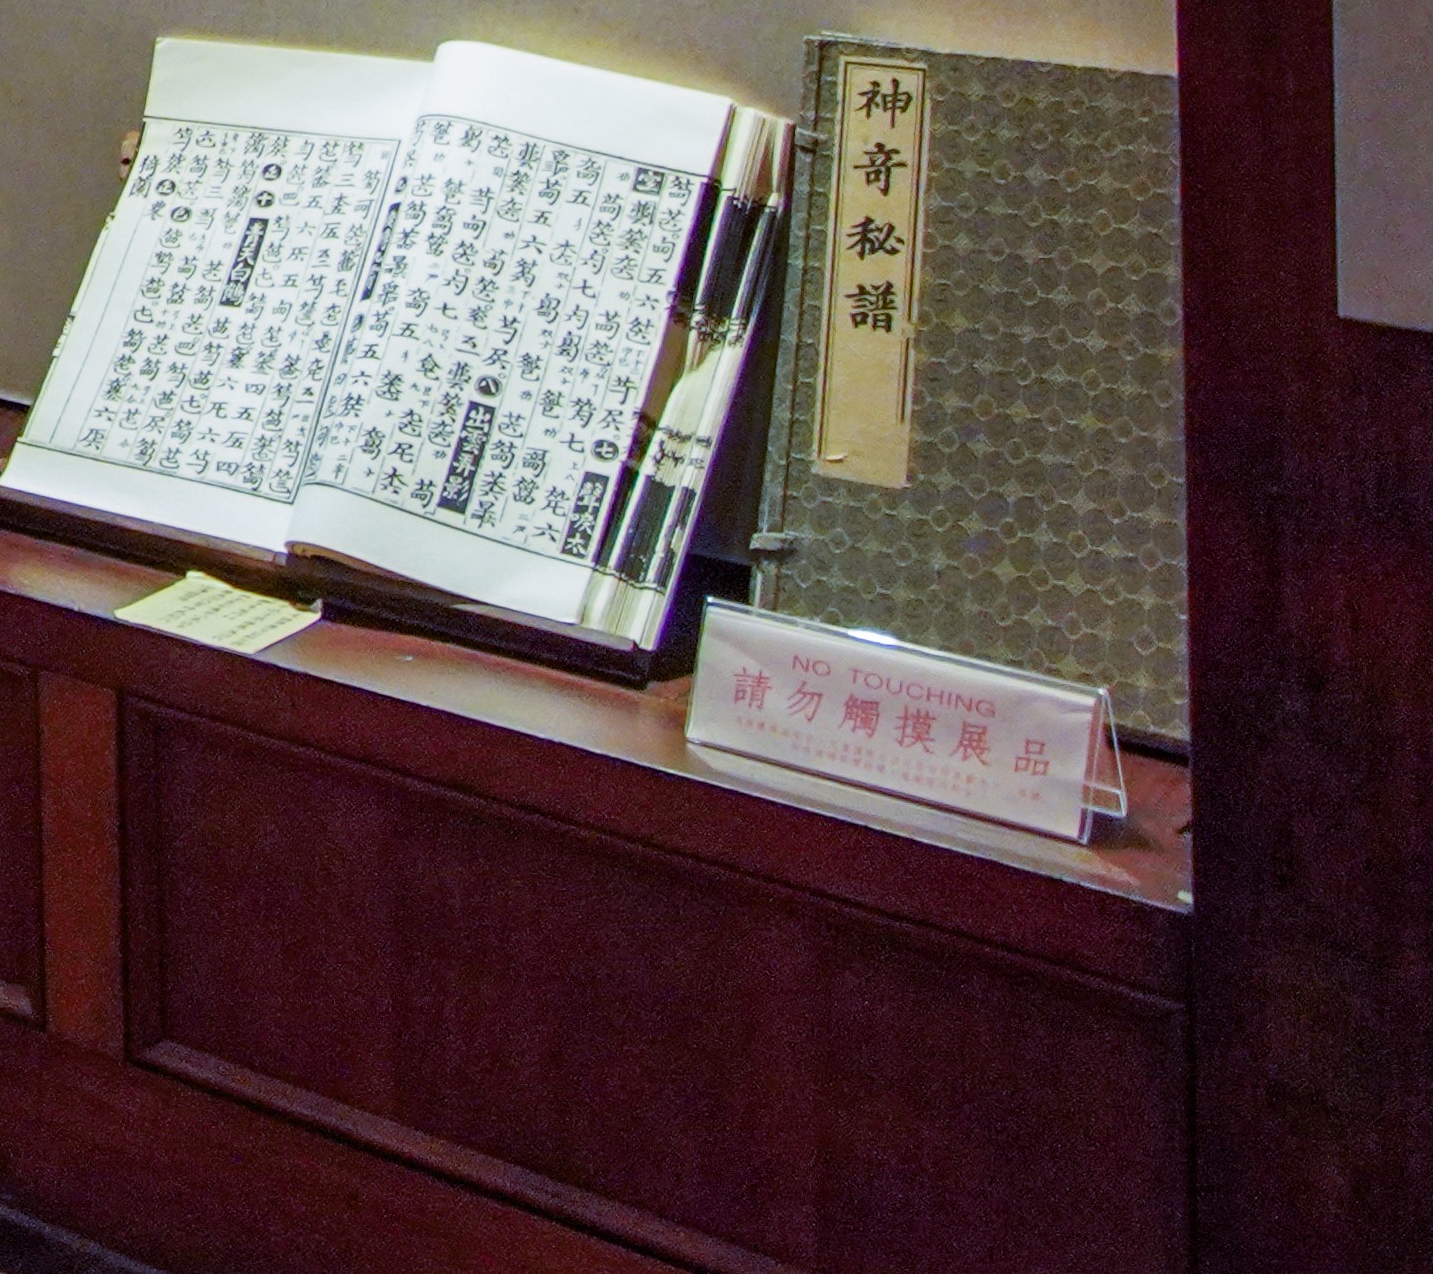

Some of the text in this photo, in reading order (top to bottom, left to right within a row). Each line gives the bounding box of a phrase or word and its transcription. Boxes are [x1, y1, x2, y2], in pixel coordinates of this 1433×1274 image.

[732, 666, 1051, 778] 請勿觸摸展品
[791, 653, 997, 719] NO TOUCHING
